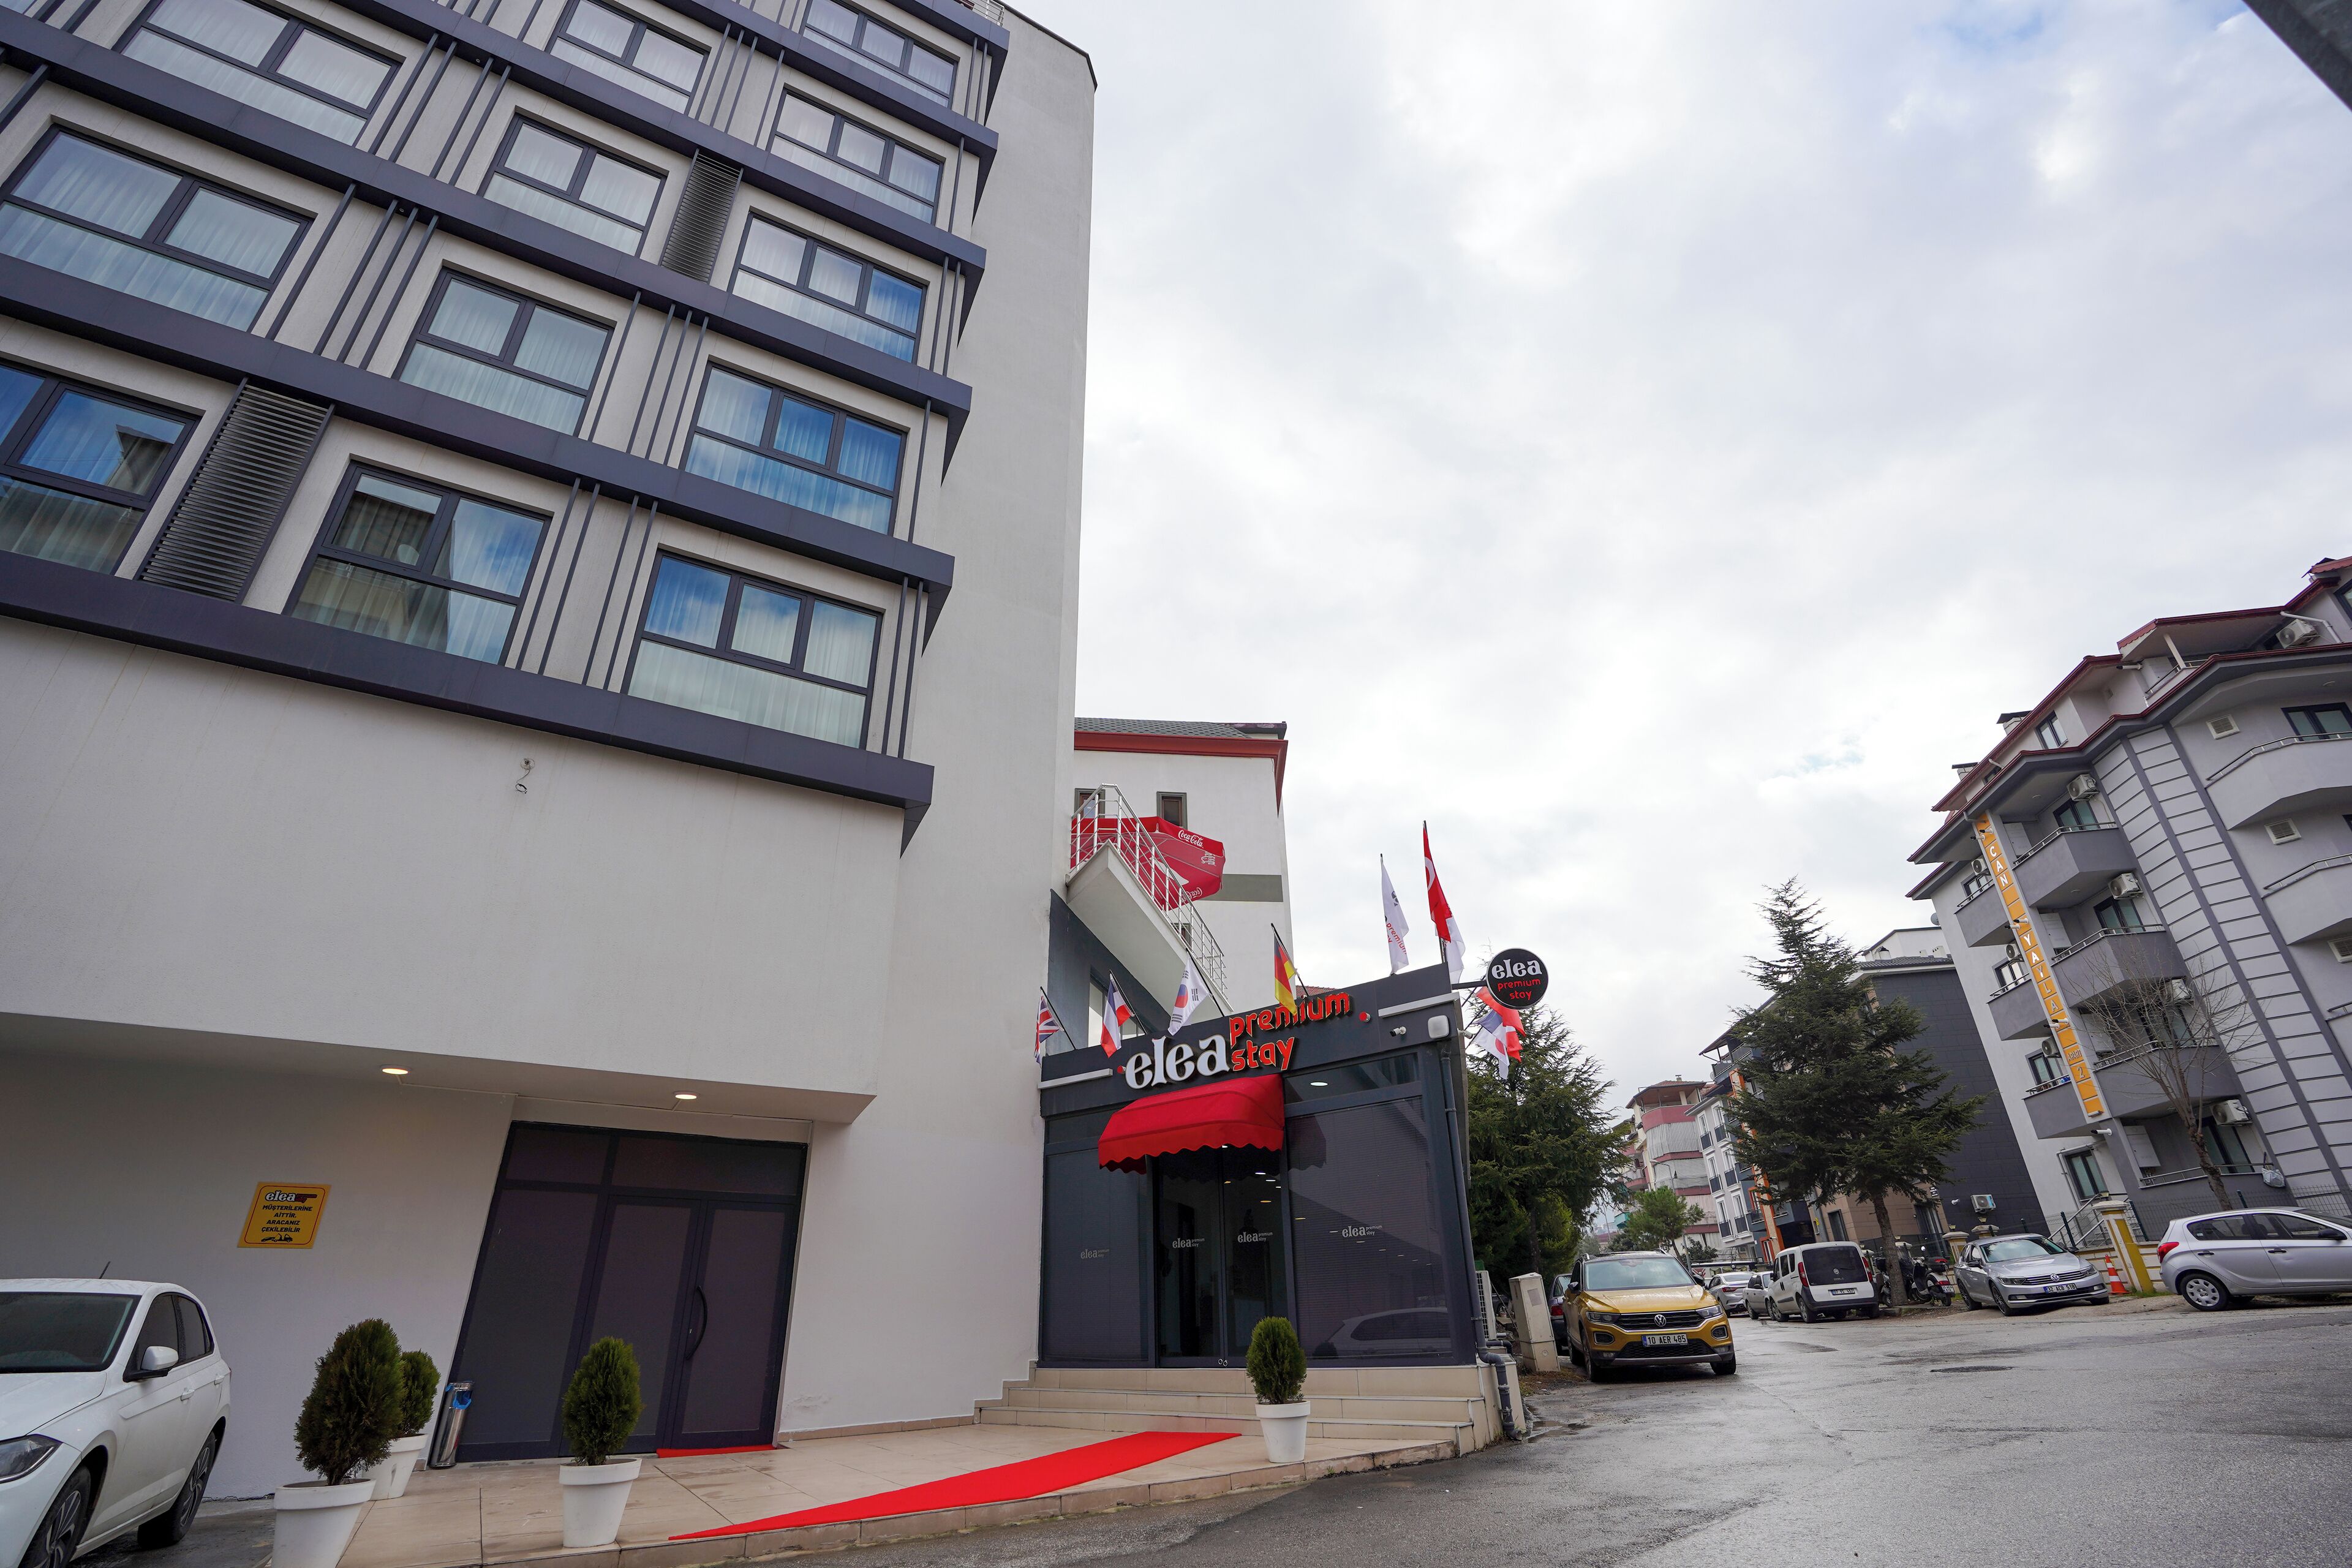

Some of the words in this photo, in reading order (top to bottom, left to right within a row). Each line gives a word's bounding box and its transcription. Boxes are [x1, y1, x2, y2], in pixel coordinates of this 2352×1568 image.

[1989, 846, 2008, 886] CAN
[1491, 959, 1542, 979] elea
[2023, 933, 2059, 1012] YAYLA
[1498, 979, 1541, 992] premium
[1509, 990, 1532, 1000] stay
[1229, 992, 1351, 1050] premium
[1232, 1036, 1296, 1072] stay
[2067, 1049, 2082, 1061] APART
[1125, 1035, 1231, 1090] elea
[2078, 1066, 2086, 1079] 2
[265, 1191, 296, 1202] elea
[1237, 1231, 1259, 1243] elea
[1342, 1225, 1366, 1238] elea
[1172, 1237, 1192, 1249] elea
[1080, 1248, 1098, 1259] elea
